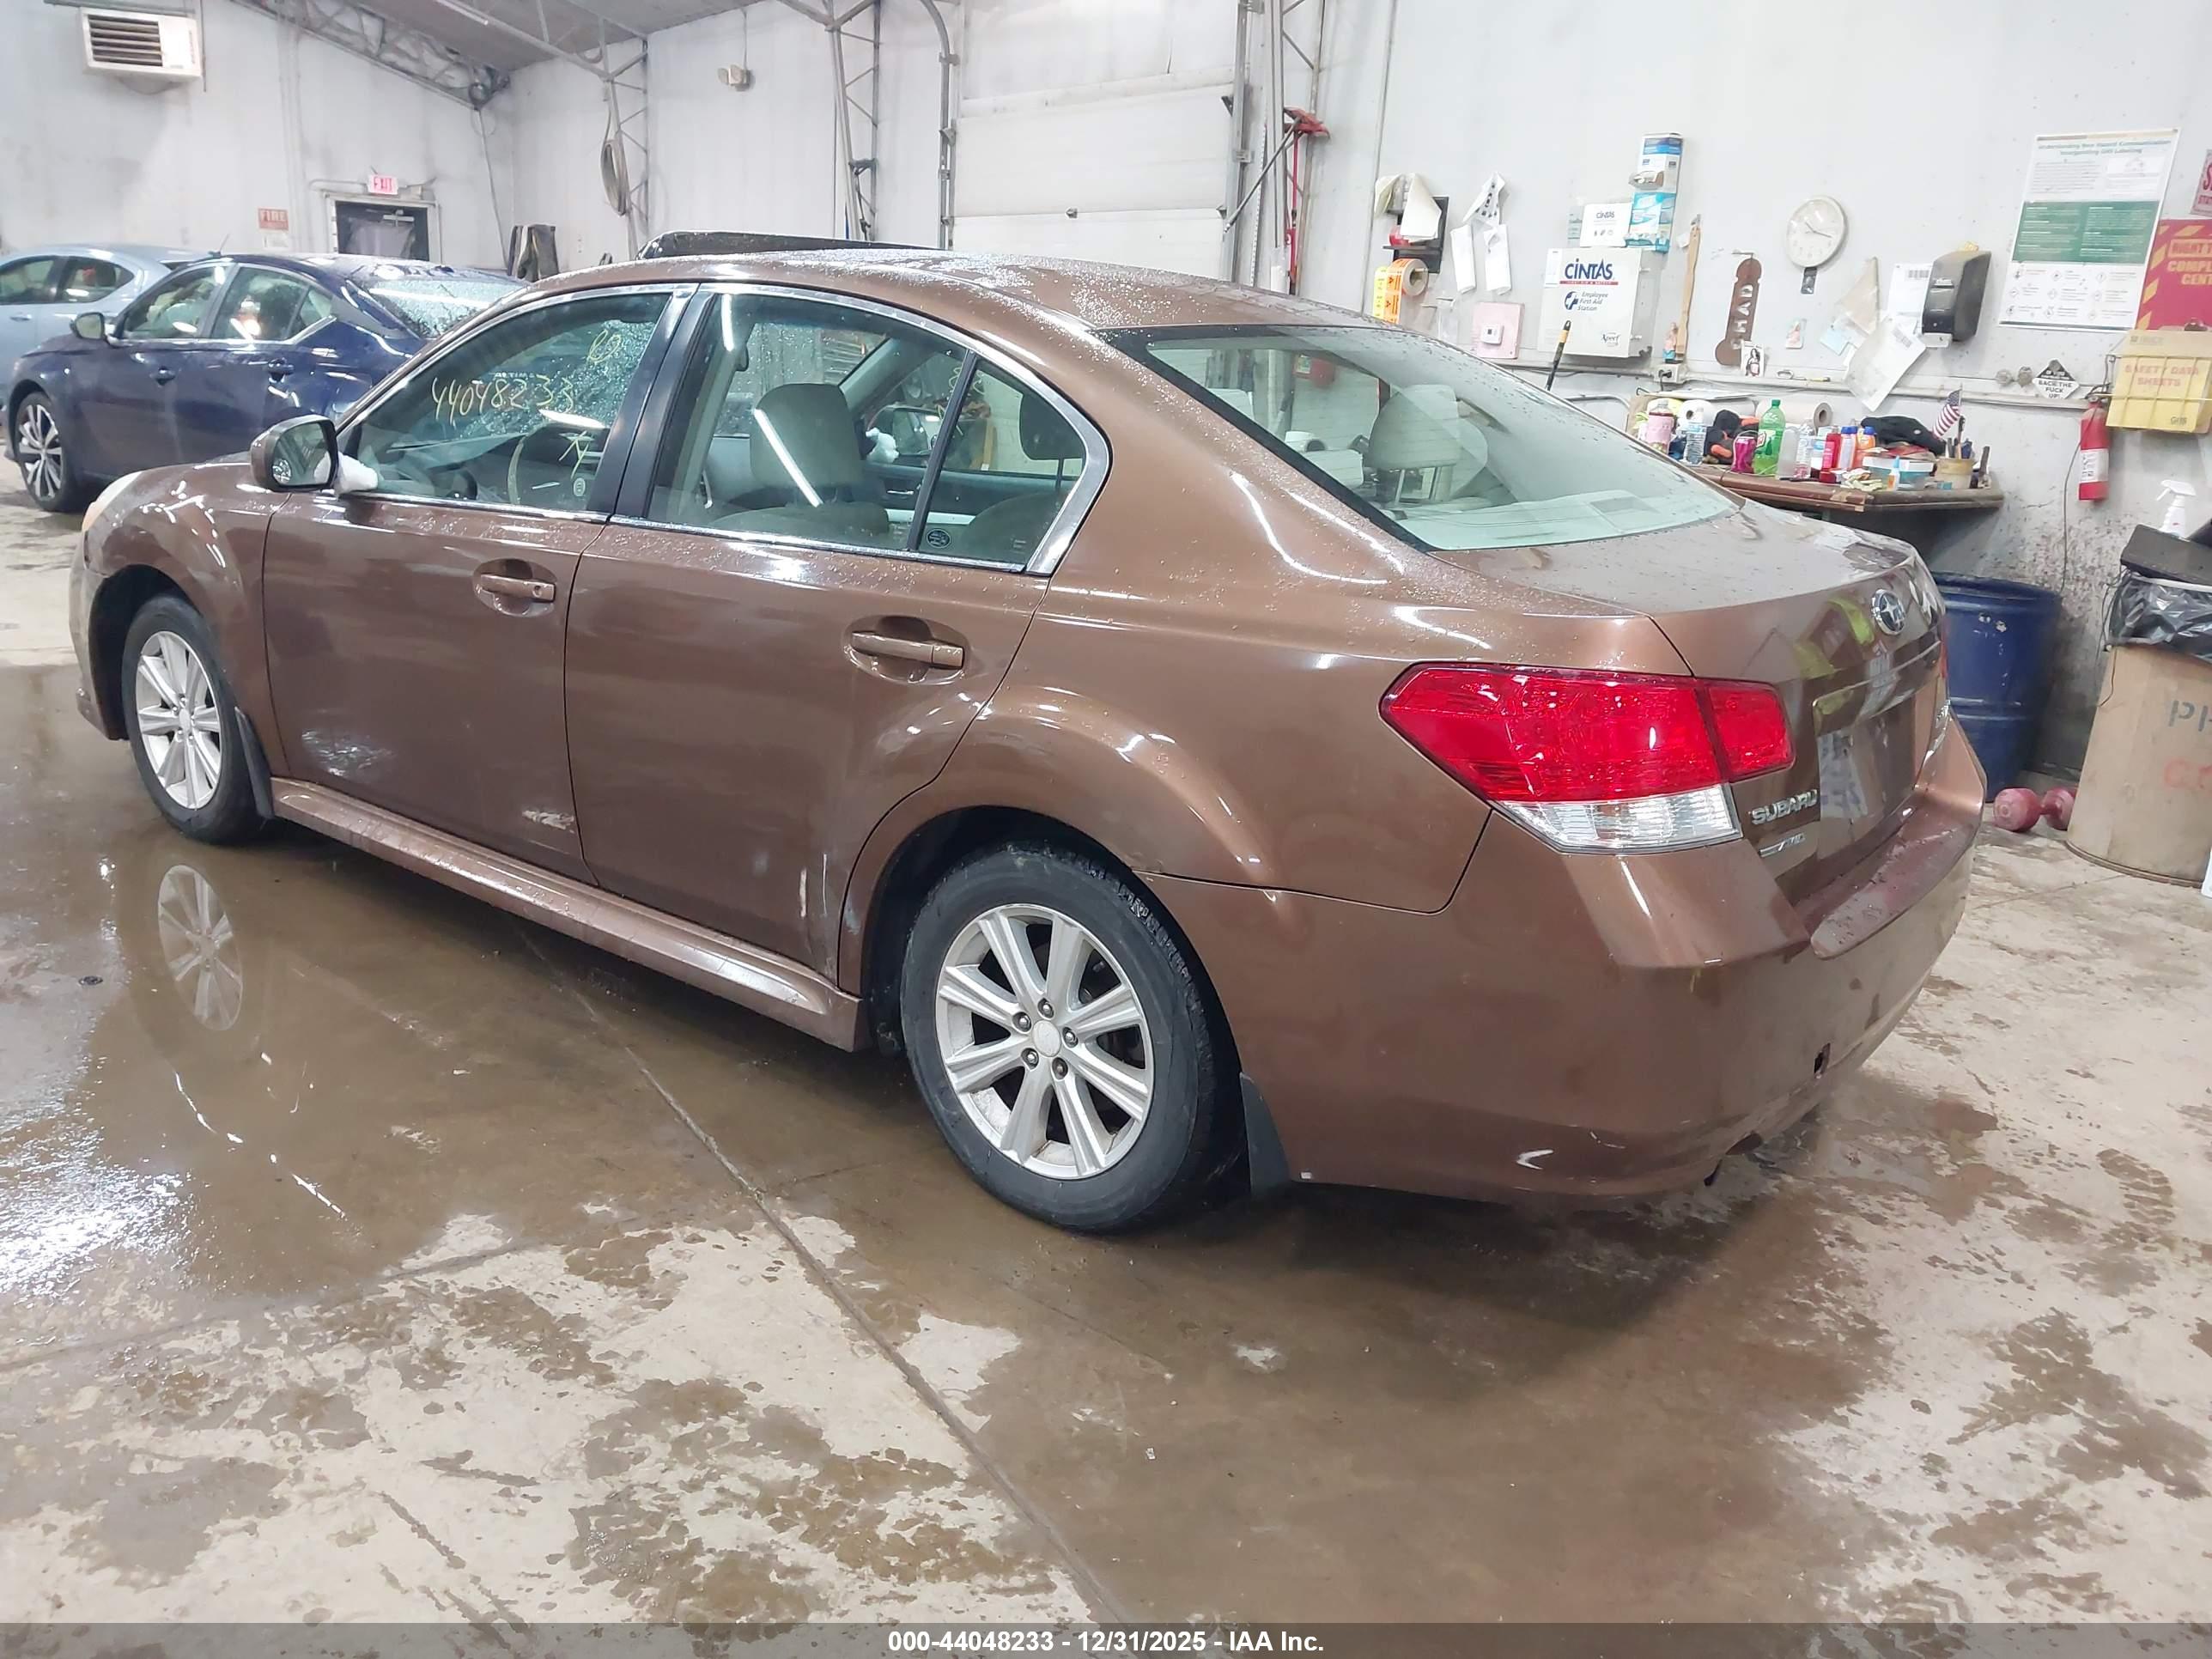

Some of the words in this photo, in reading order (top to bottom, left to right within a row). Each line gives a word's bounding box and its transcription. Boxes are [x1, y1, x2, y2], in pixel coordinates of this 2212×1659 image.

[374, 177, 394, 191] EXIT
[260, 209, 285, 222] FIRE
[432, 374, 574, 425] 44048233
[1751, 789, 1818, 824] SUBARU
